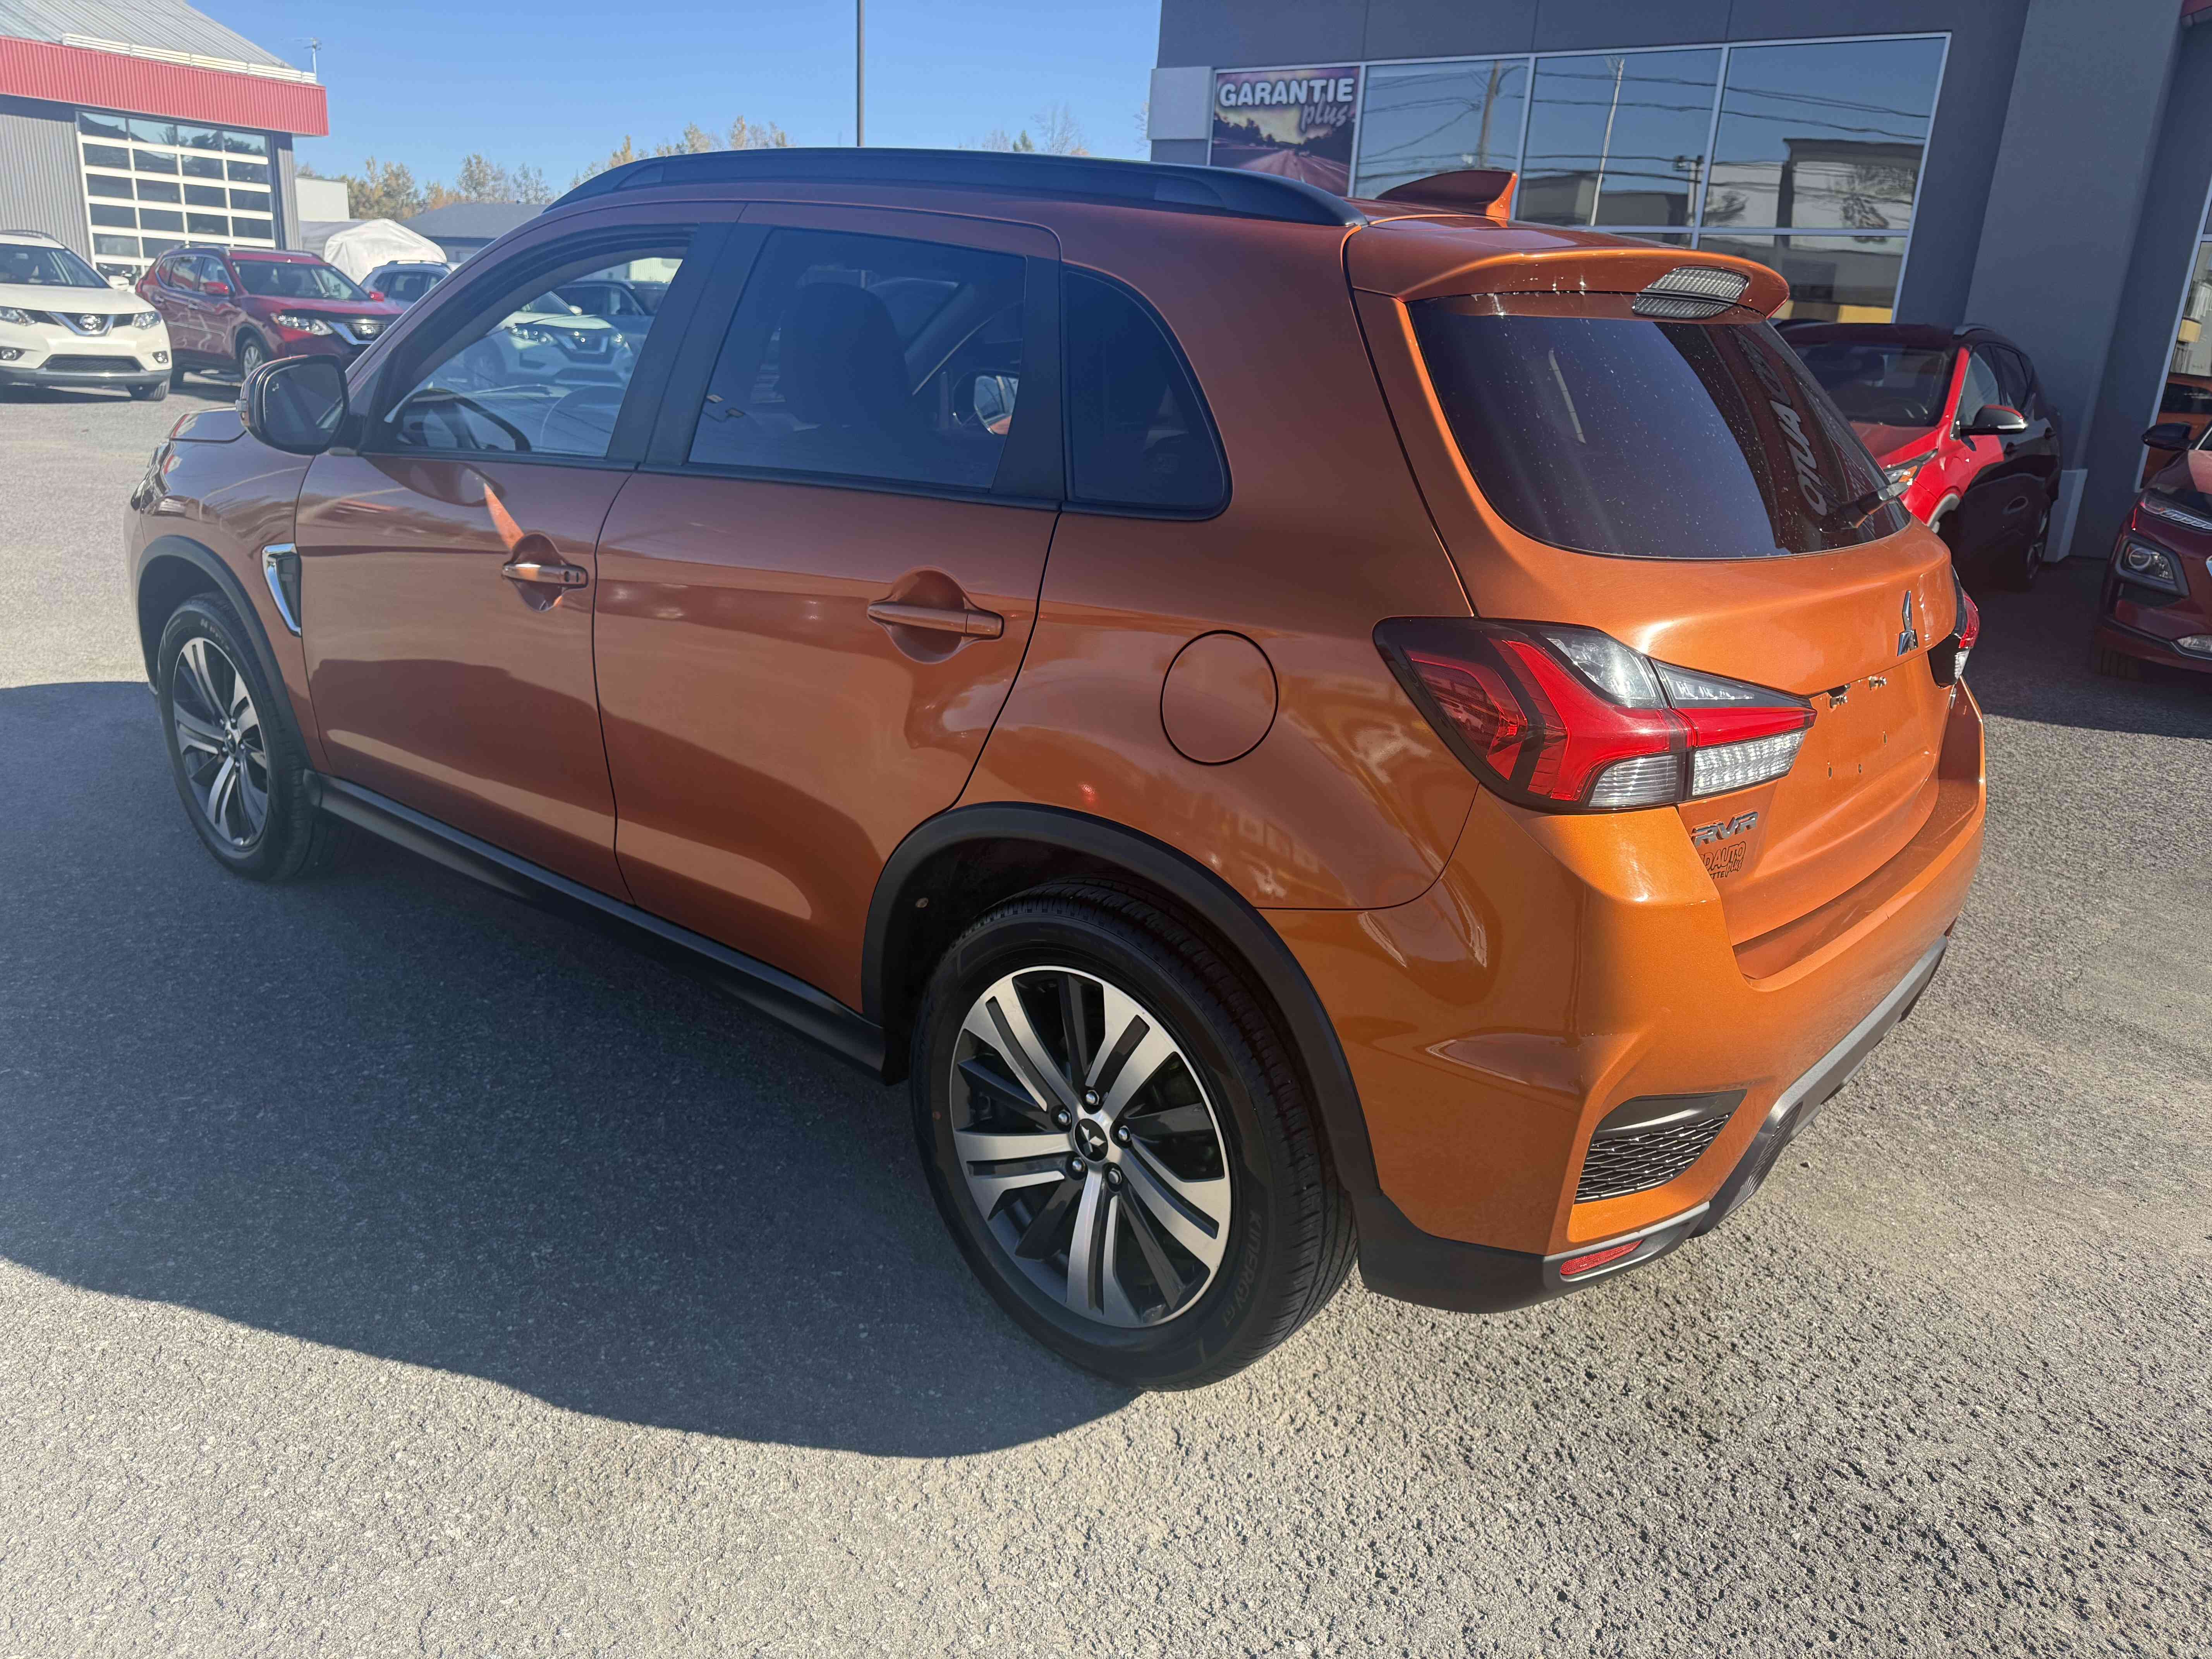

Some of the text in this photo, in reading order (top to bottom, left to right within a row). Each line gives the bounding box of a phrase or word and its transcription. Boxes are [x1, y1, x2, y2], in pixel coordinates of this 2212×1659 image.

[1219, 77, 1355, 107] GARANTIE
[1300, 96, 1348, 131] plus
[1691, 810, 1759, 847] RVR
[1234, 1209, 1264, 1310] KINERGY
